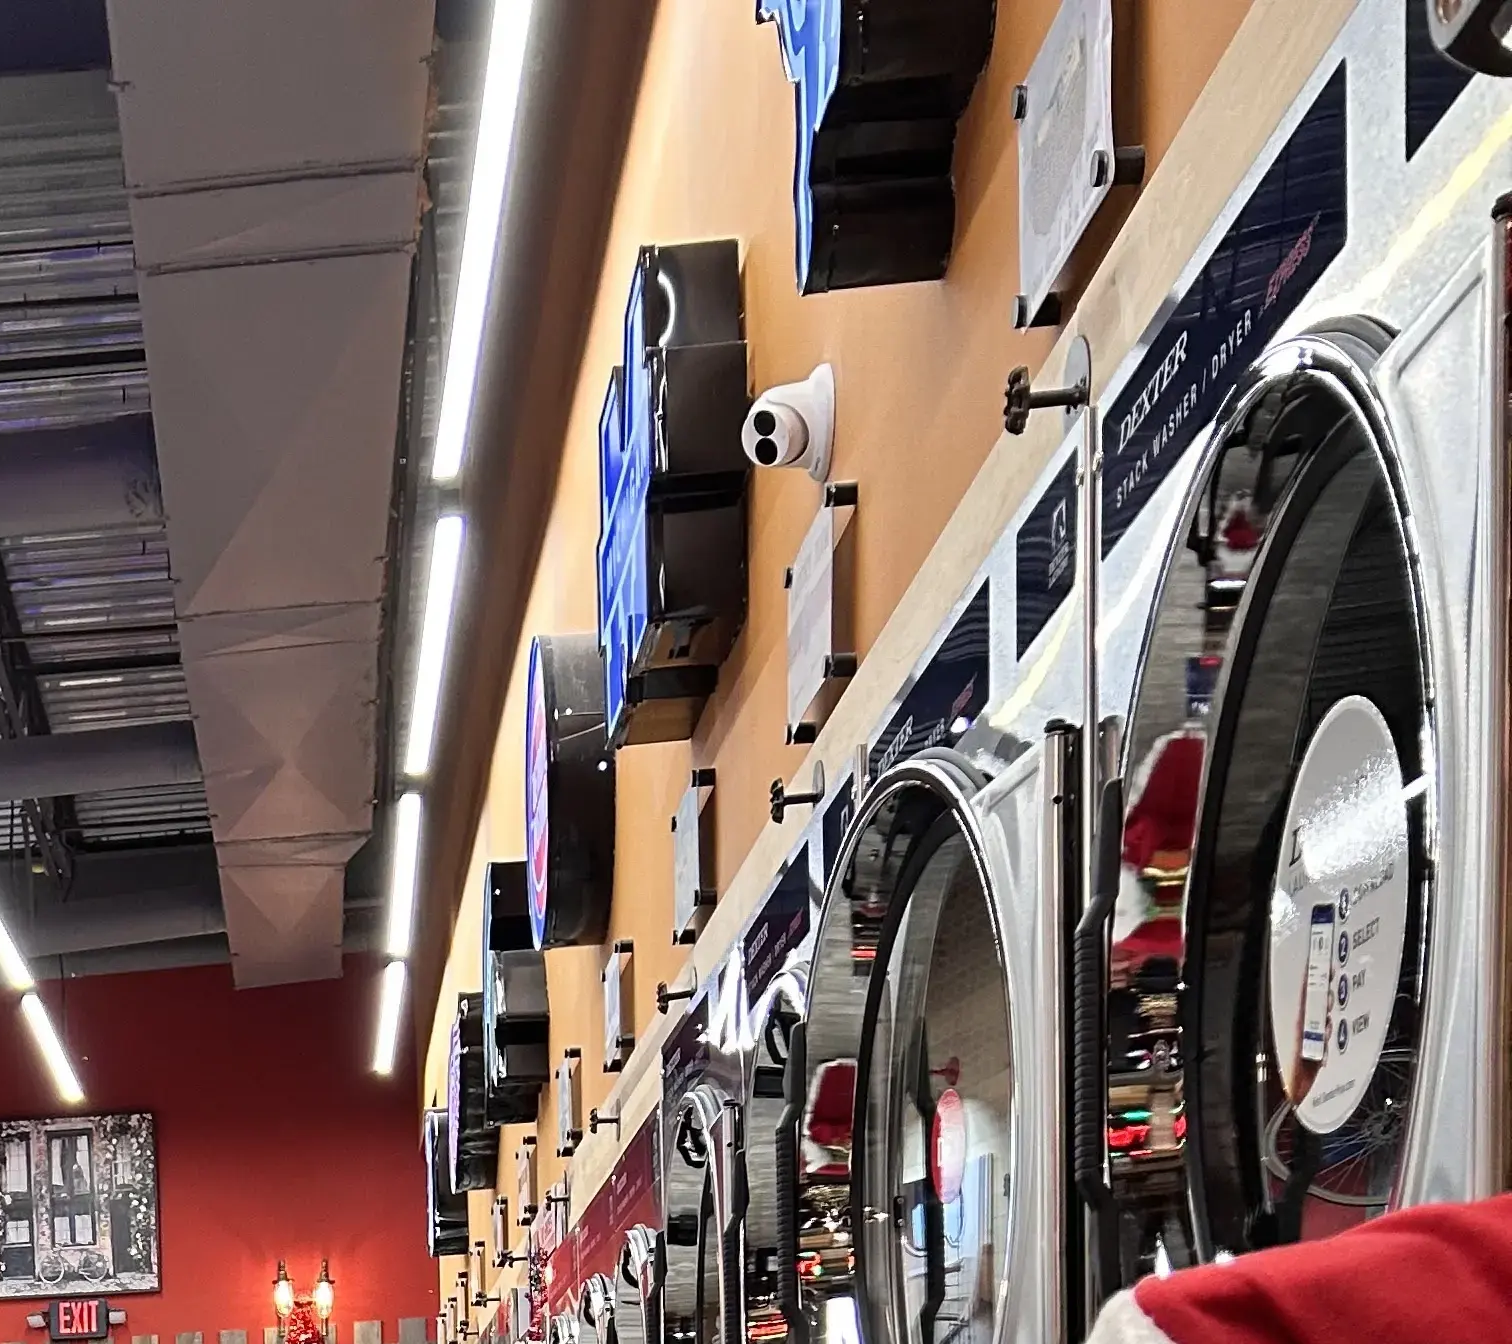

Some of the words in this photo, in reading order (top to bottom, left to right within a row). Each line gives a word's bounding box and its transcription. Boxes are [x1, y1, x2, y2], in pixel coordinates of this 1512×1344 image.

[1116, 452, 1149, 508] STACK
[1153, 384, 1198, 458] WASHER
[1211, 309, 1252, 380] DRYER
[1117, 331, 1188, 455] DEXTER
[1352, 916, 1380, 950] SELECT
[1352, 969, 1367, 992] PAY
[1352, 1010, 1370, 1036] VIEW
[59, 1300, 99, 1334] EXIT
